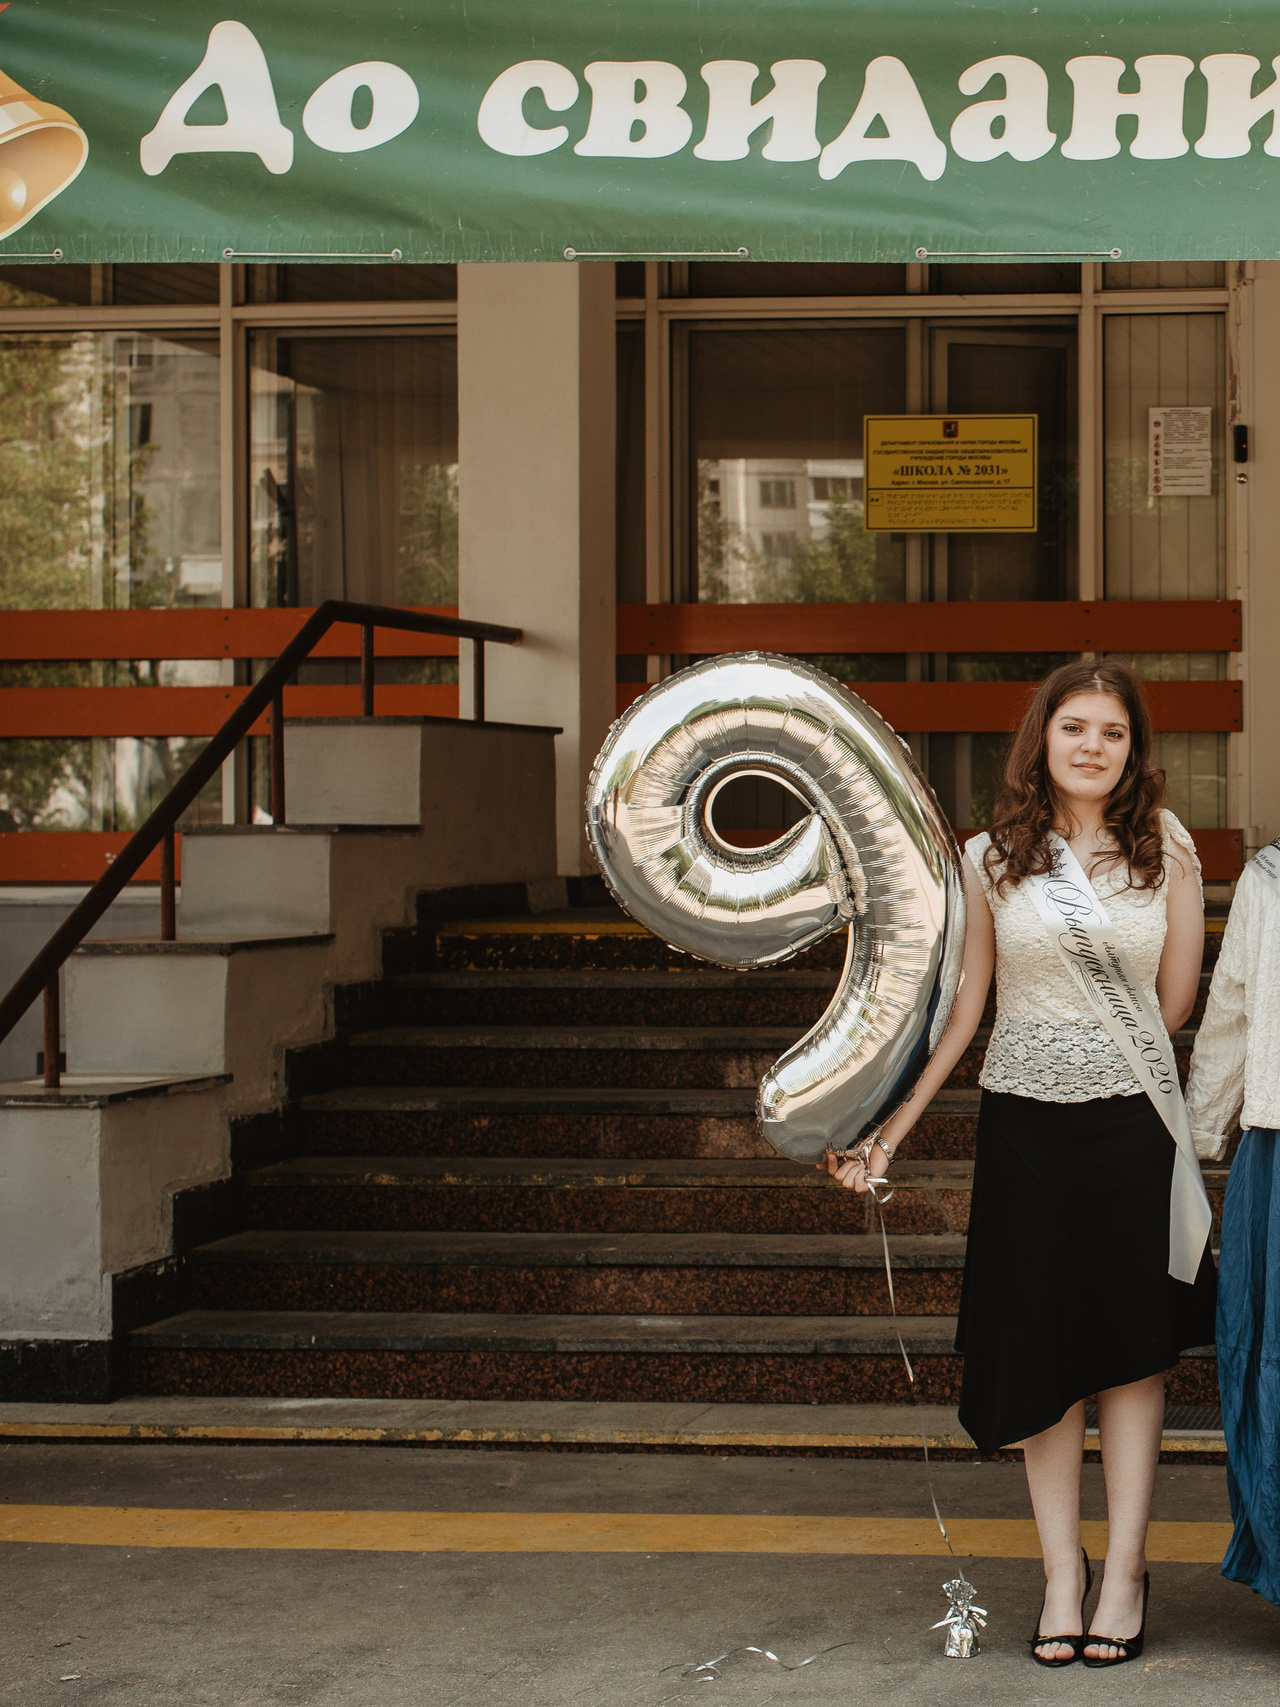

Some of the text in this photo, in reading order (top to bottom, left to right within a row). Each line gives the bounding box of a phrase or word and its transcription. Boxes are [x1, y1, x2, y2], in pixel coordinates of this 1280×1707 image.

[140, 20, 420, 176] До
[893, 464, 1008, 476] «ШКОЛА № 2031»
[585, 651, 966, 1165] 9
[1042, 879, 1178, 1095] Выпускница 2026
